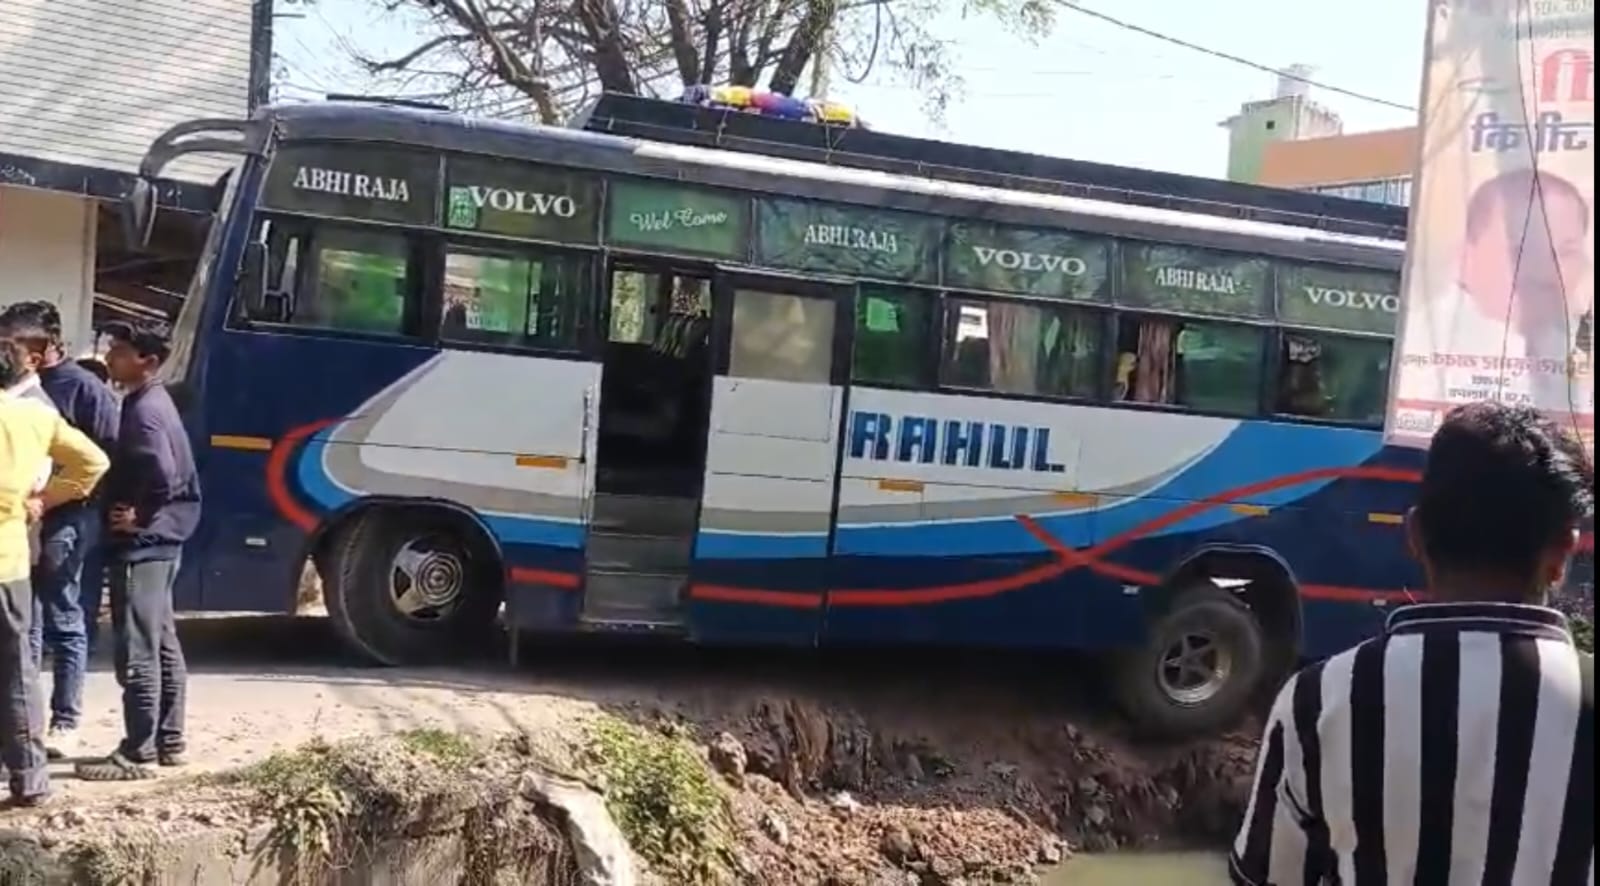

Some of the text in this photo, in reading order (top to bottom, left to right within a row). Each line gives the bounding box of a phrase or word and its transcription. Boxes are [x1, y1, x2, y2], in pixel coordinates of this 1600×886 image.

[293, 165, 409, 202] ABHI RAJA
[470, 185, 576, 218] VOLVO
[630, 210, 673, 232] Wel
[804, 224, 898, 254] ABHI RAJA
[972, 245, 1087, 278] VOLVO
[1156, 267, 1235, 295] ABHI RAJA
[1304, 286, 1400, 314] VOLVO
[848, 410, 1066, 473] RAHUL
